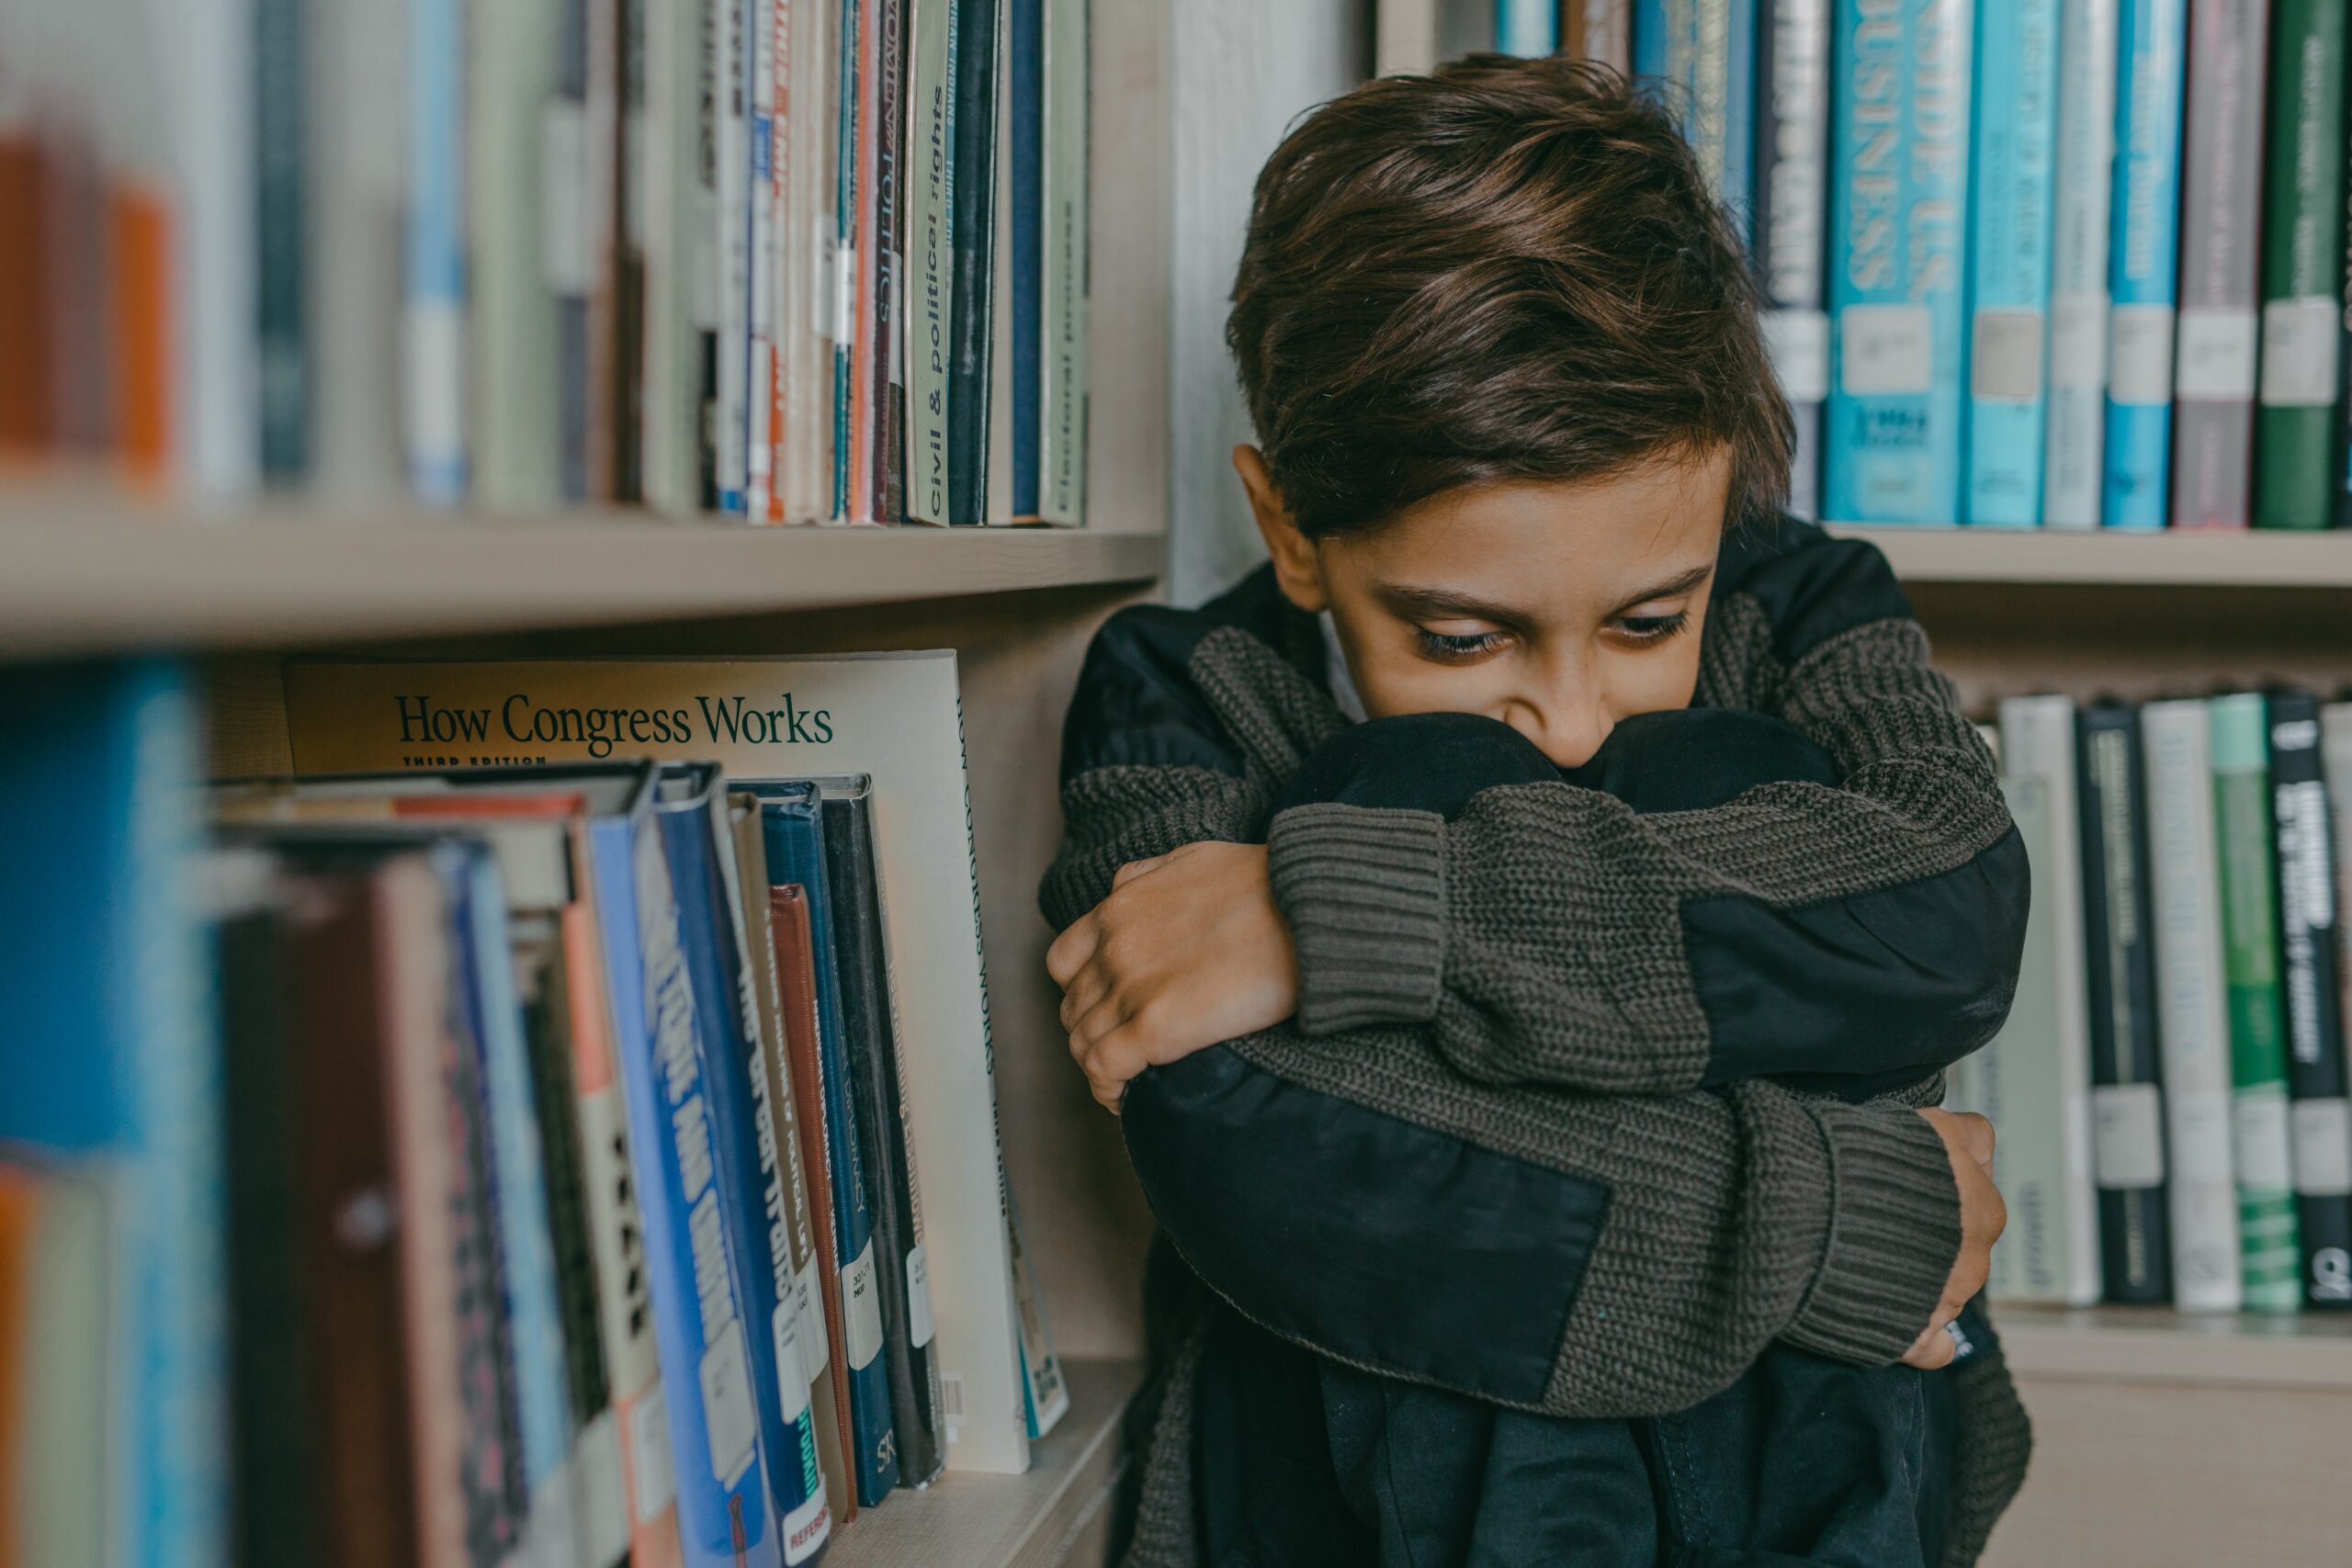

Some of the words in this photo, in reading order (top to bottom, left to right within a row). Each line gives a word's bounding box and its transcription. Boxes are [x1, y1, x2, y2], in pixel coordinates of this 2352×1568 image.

[945, 57, 958, 127] INDIANS
[929, 85, 944, 200] rights
[944, 158, 956, 210] THIRD
[879, 153, 897, 322] POLITICS
[925, 211, 944, 374] political
[929, 388, 941, 416] &
[1056, 353, 1073, 513] Electoral
[930, 428, 942, 517] Civil
[393, 694, 492, 742] How
[502, 694, 692, 759] Congress
[695, 692, 833, 744] Works
[402, 756, 459, 767] THIRD
[469, 755, 547, 766] EDITION
[774, 1013, 790, 1099] ANALYSIS
[888, 960, 911, 1121] Reevaluating
[783, 1100, 793, 1122] OF
[813, 998, 824, 1084] AMERICAN
[820, 1084, 831, 1180] DIPLOMACY
[786, 1129, 803, 1223] POLITICAL
[844, 1077, 865, 1213] DIPLOMACY
[797, 1223, 808, 1263] LIFE
